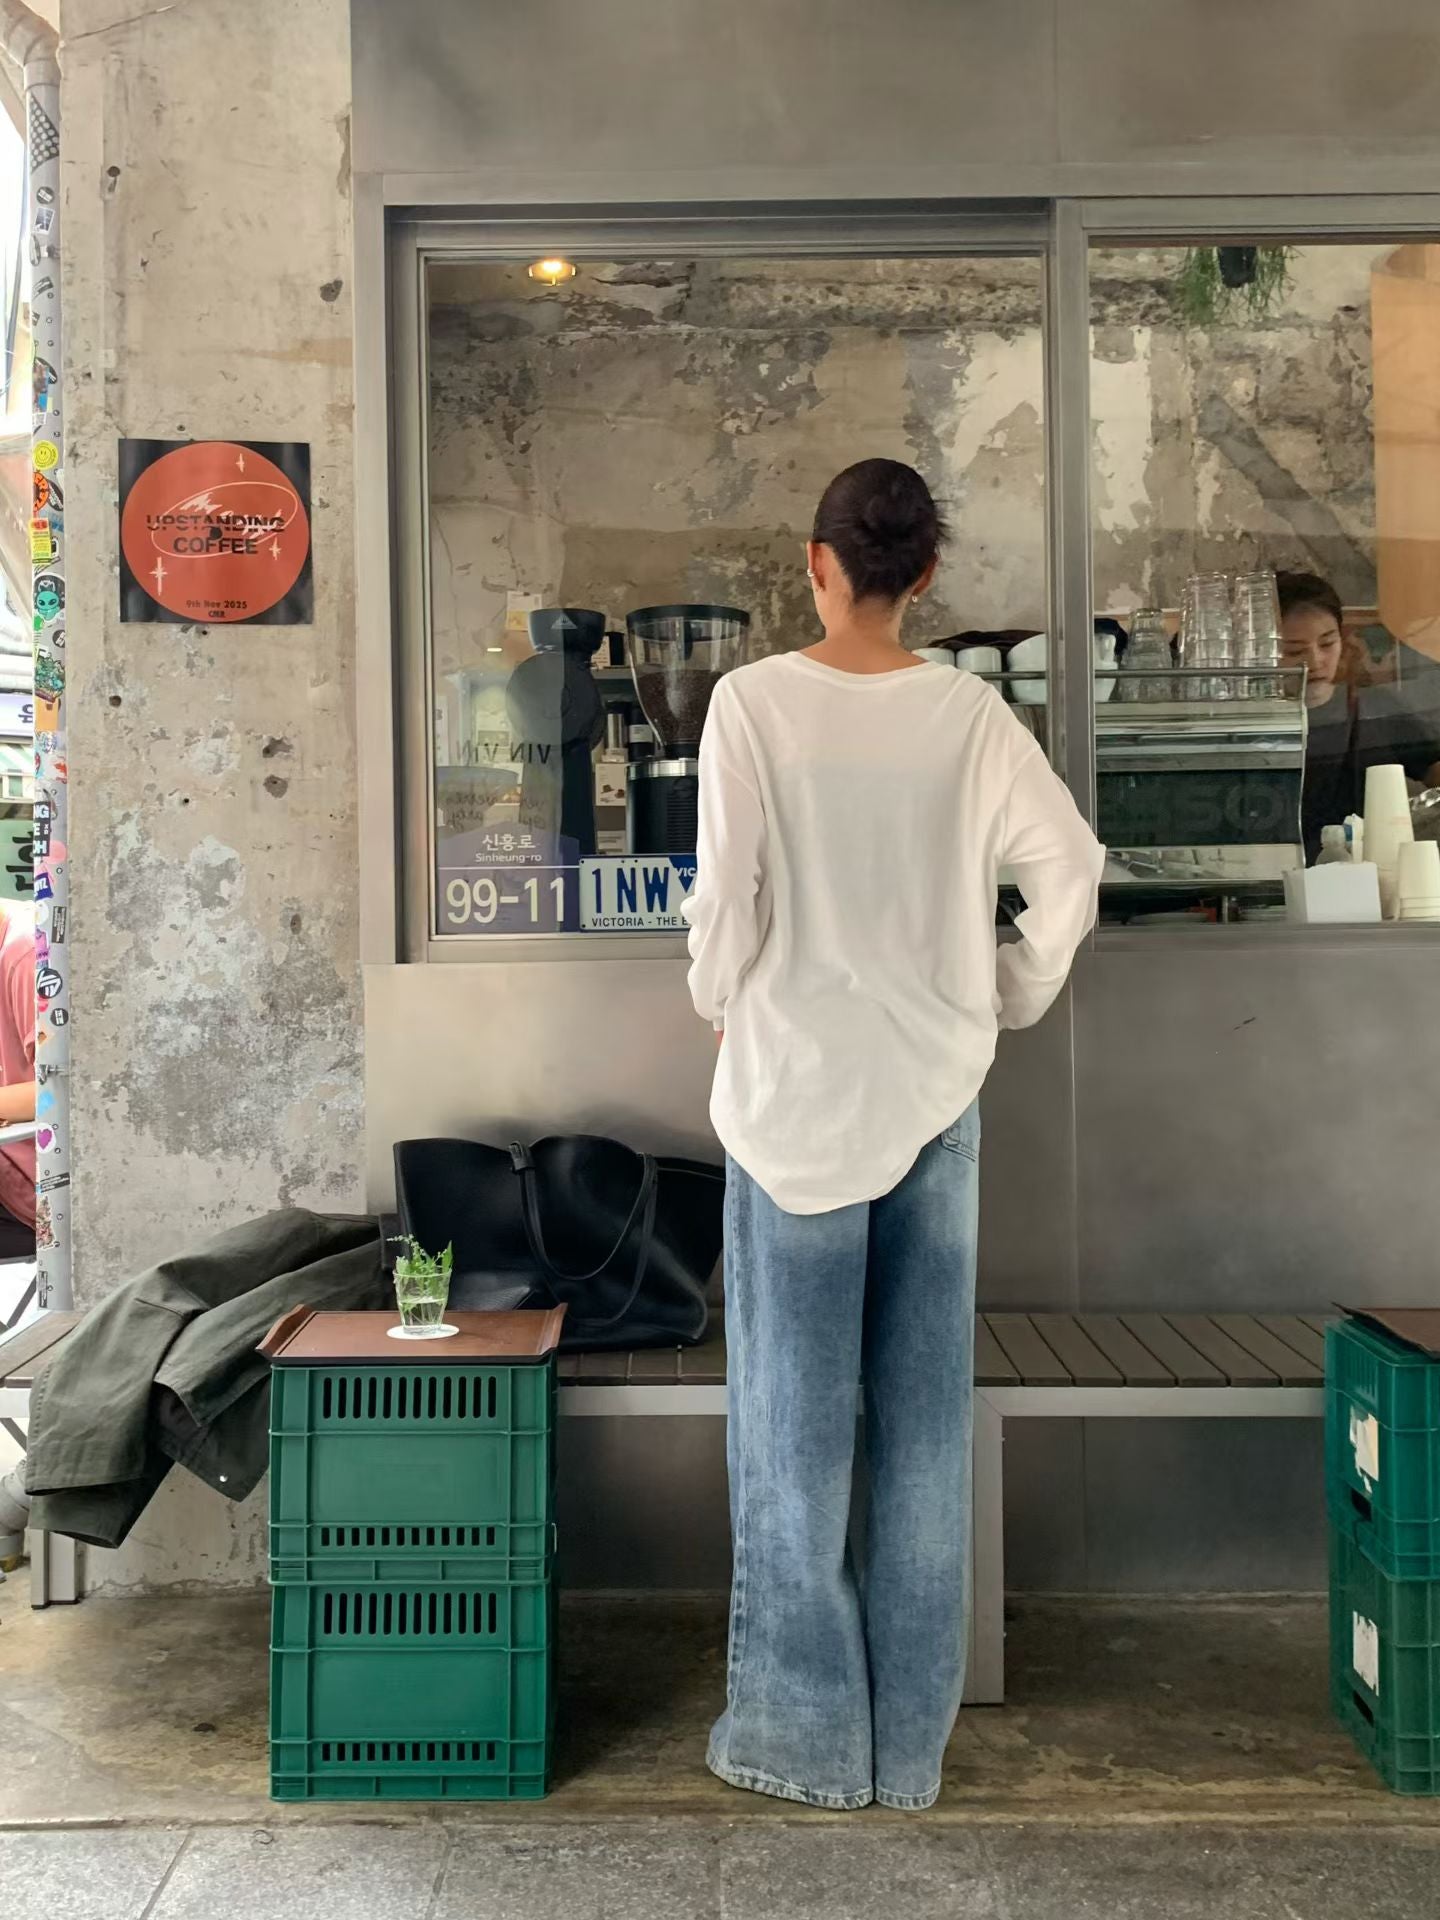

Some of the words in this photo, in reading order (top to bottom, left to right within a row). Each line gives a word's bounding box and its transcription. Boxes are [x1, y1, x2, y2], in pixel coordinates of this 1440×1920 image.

[147, 515, 284, 532] UPSTANDING
[174, 537, 258, 554] COFFEE
[224, 600, 247, 609] 2025
[482, 833, 537, 850] 신흥로
[475, 853, 542, 864] Sinheung-ro
[674, 867, 697, 877] VIC
[447, 877, 564, 923] 99-11
[592, 917, 645, 927] VICTORIA
[656, 916, 678, 926] THE
